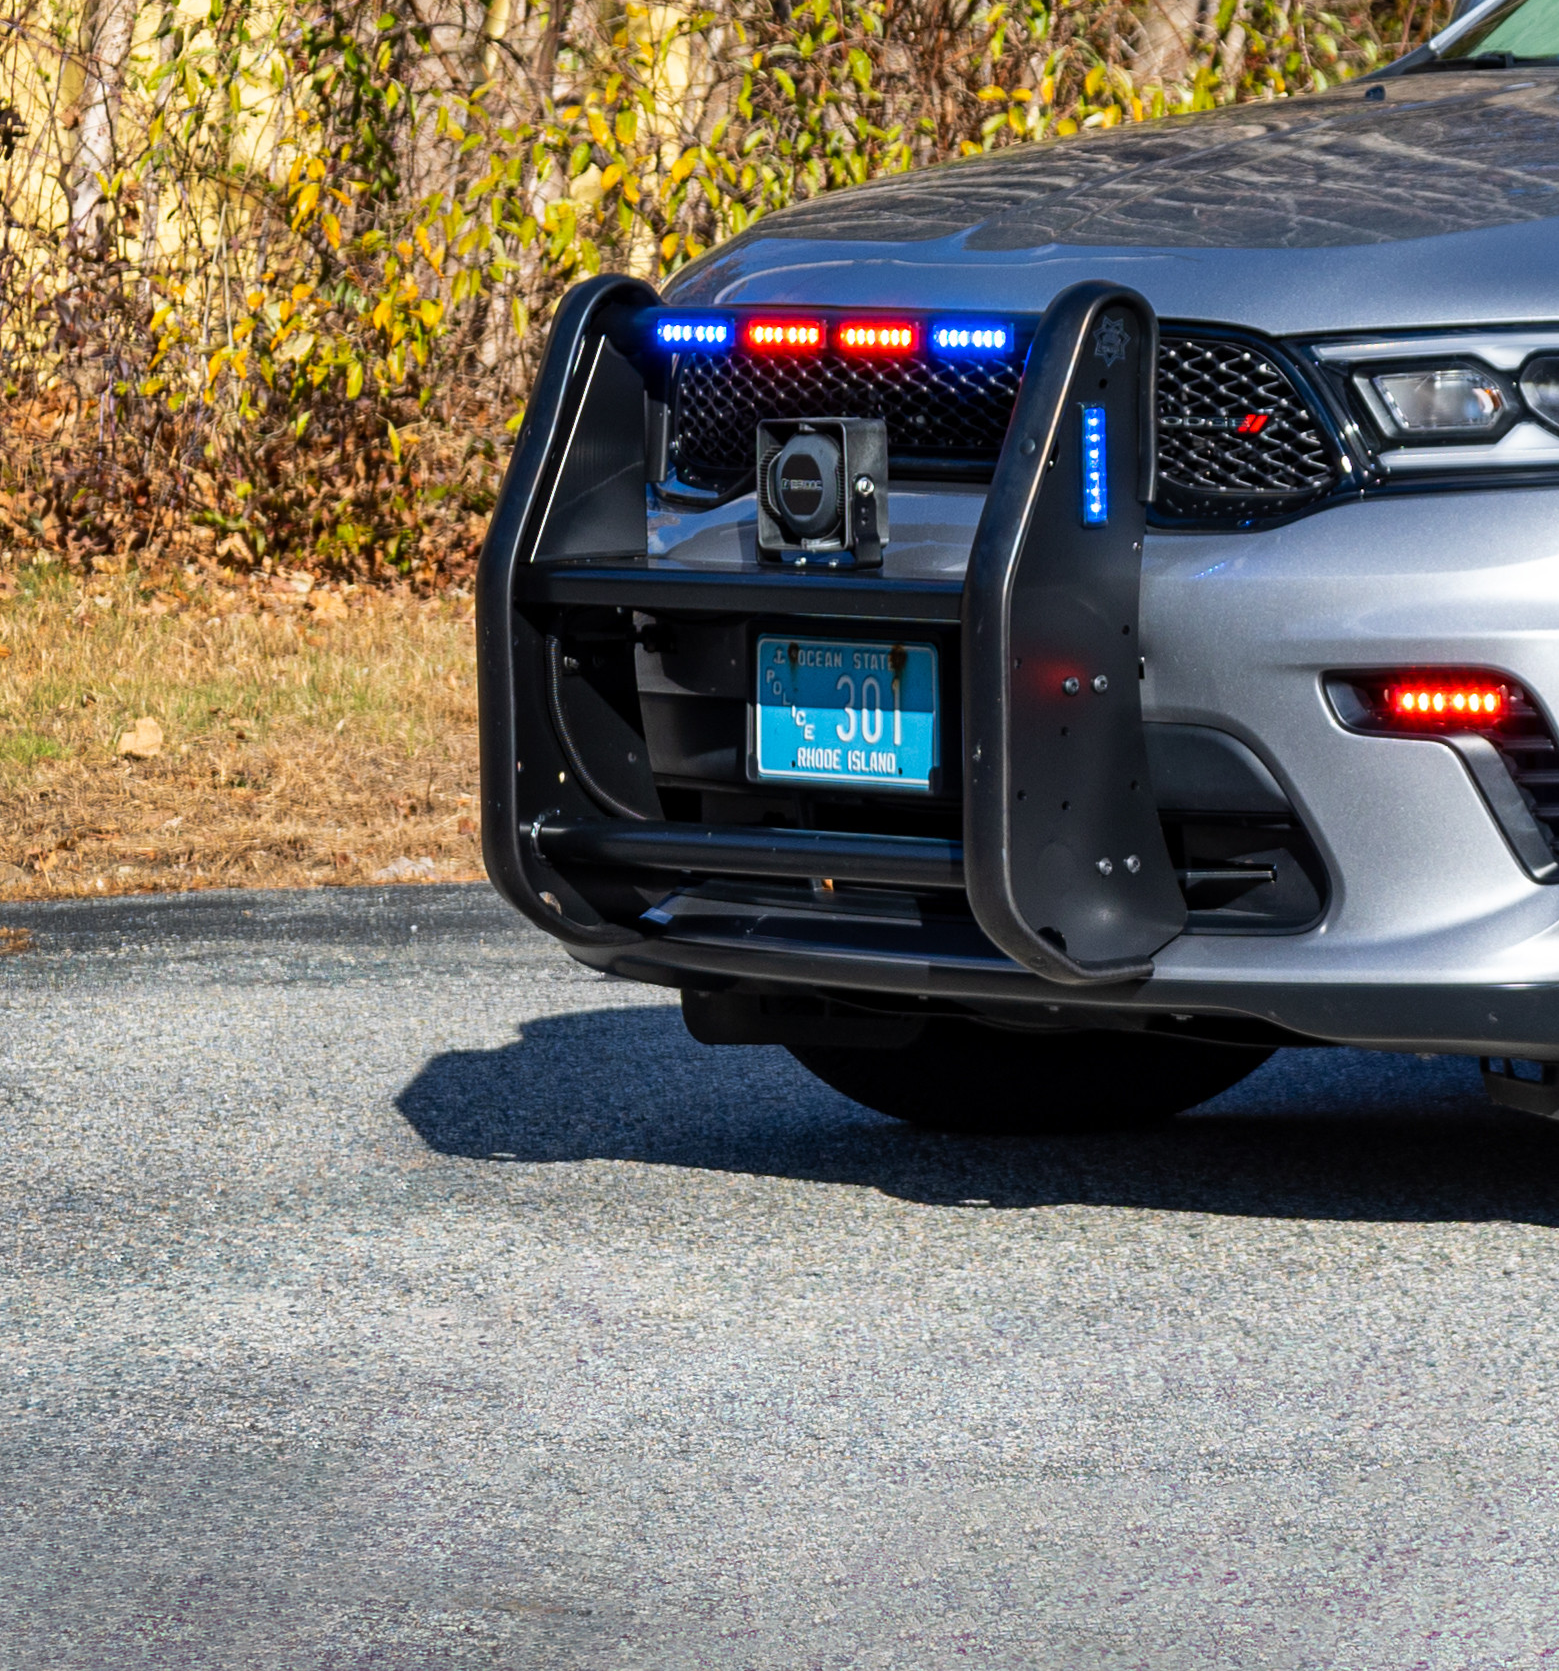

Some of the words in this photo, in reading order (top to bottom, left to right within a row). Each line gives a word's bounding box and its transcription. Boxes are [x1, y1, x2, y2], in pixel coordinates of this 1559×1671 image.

[797, 649, 843, 668] OCEAN
[766, 669, 815, 740] POLICE
[836, 674, 903, 746] 301
[797, 746, 842, 771] RHODE
[848, 749, 897, 775] ISLAND
